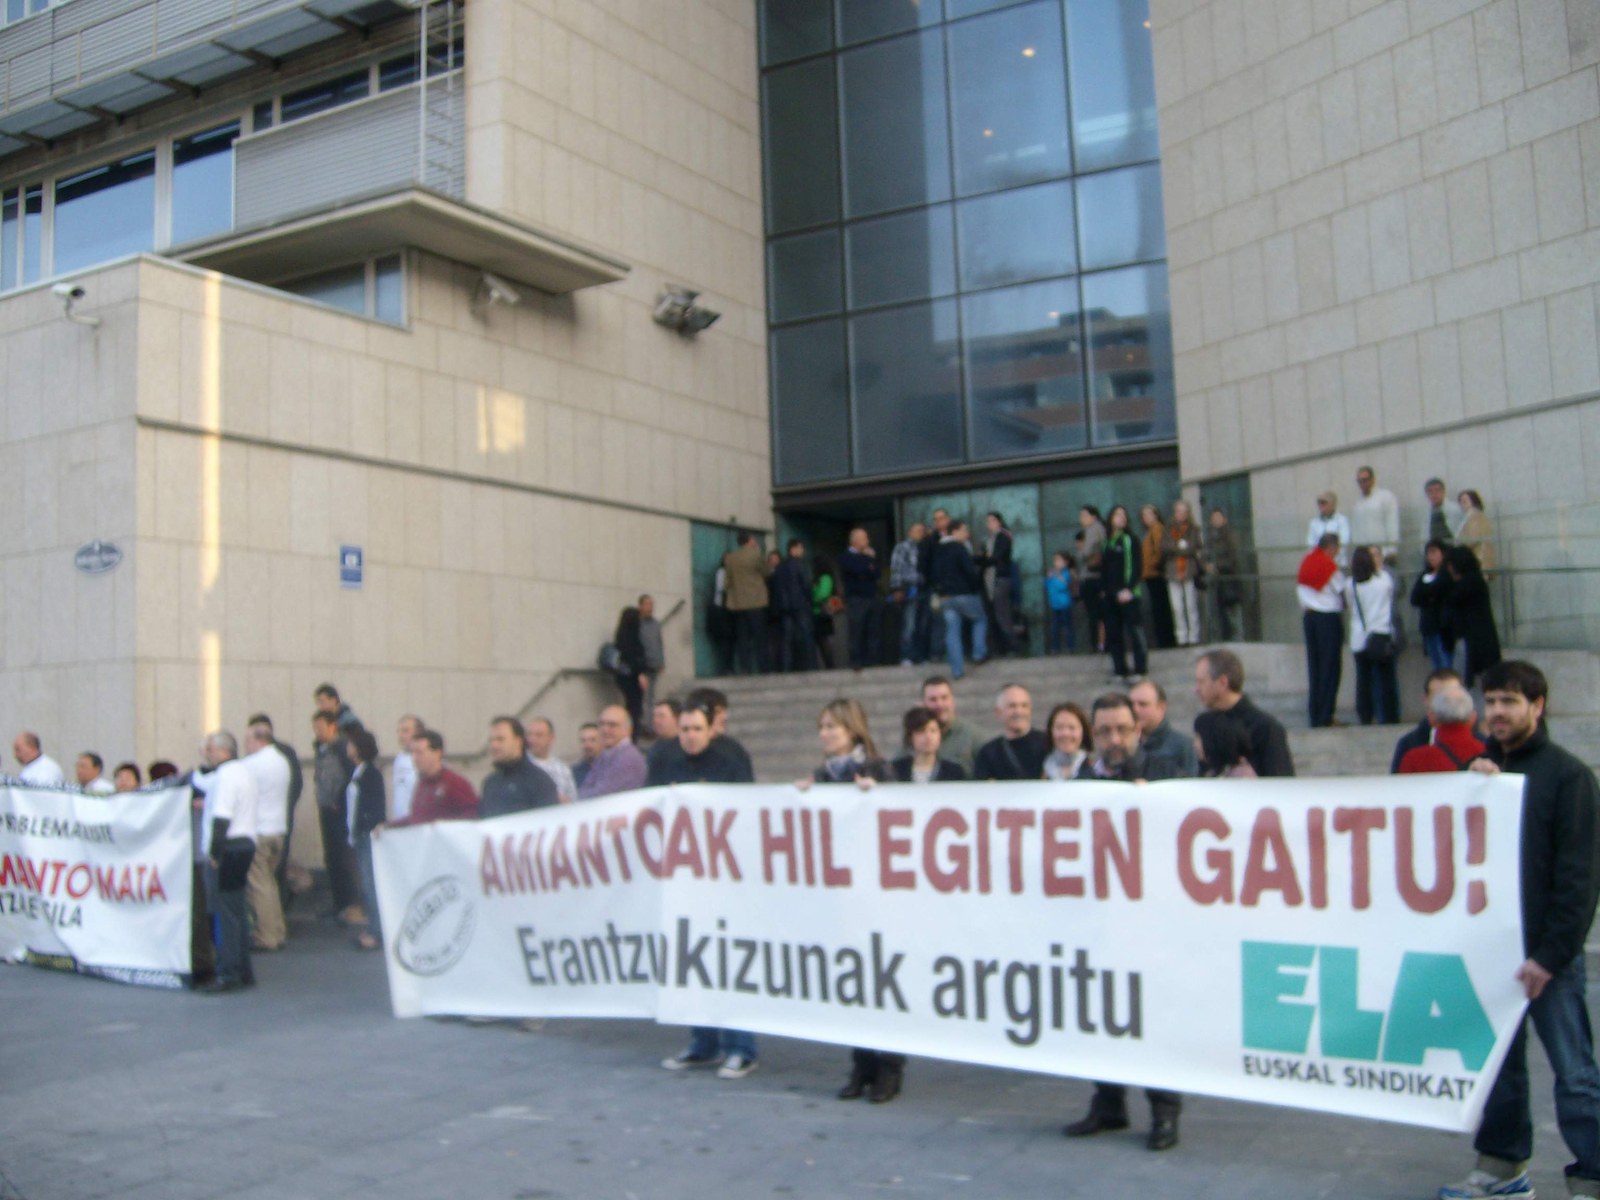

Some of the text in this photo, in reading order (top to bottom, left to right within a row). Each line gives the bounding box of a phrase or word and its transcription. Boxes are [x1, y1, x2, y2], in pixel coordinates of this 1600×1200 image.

[480, 805, 1488, 915] AMIANTOAK HIL EGITEN GAITU!
[516, 917, 910, 1013] Erantzukizunak
[932, 943, 1144, 1047] argitu
[1241, 940, 1498, 1072] ELA
[1243, 1055, 1476, 1101] EUSKAL SINDIKAT
